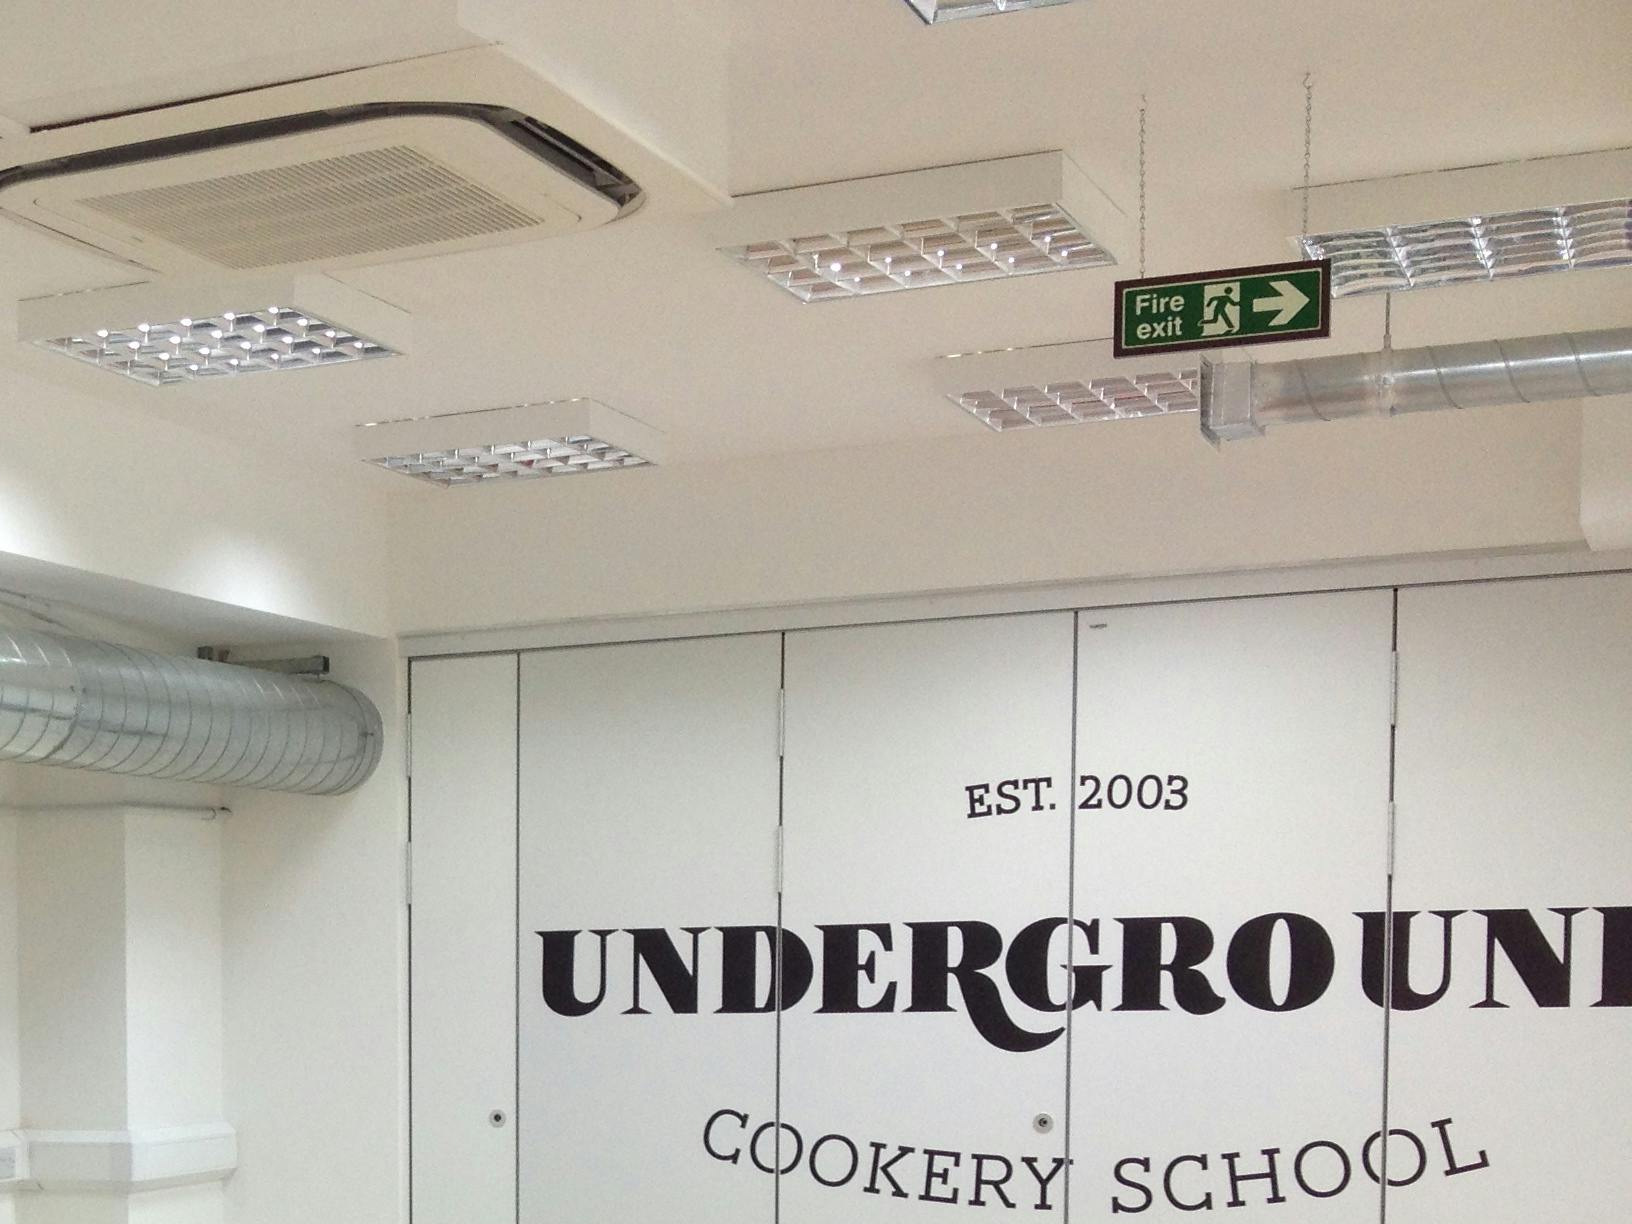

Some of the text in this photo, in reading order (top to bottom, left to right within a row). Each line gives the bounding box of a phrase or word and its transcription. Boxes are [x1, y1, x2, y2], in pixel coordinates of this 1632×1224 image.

[1135, 293, 1185, 316] Fire
[1136, 317, 1183, 340] exit
[964, 773, 1189, 819] EST. 2003
[702, 1108, 1491, 1215] COOKERY SCHOOL
